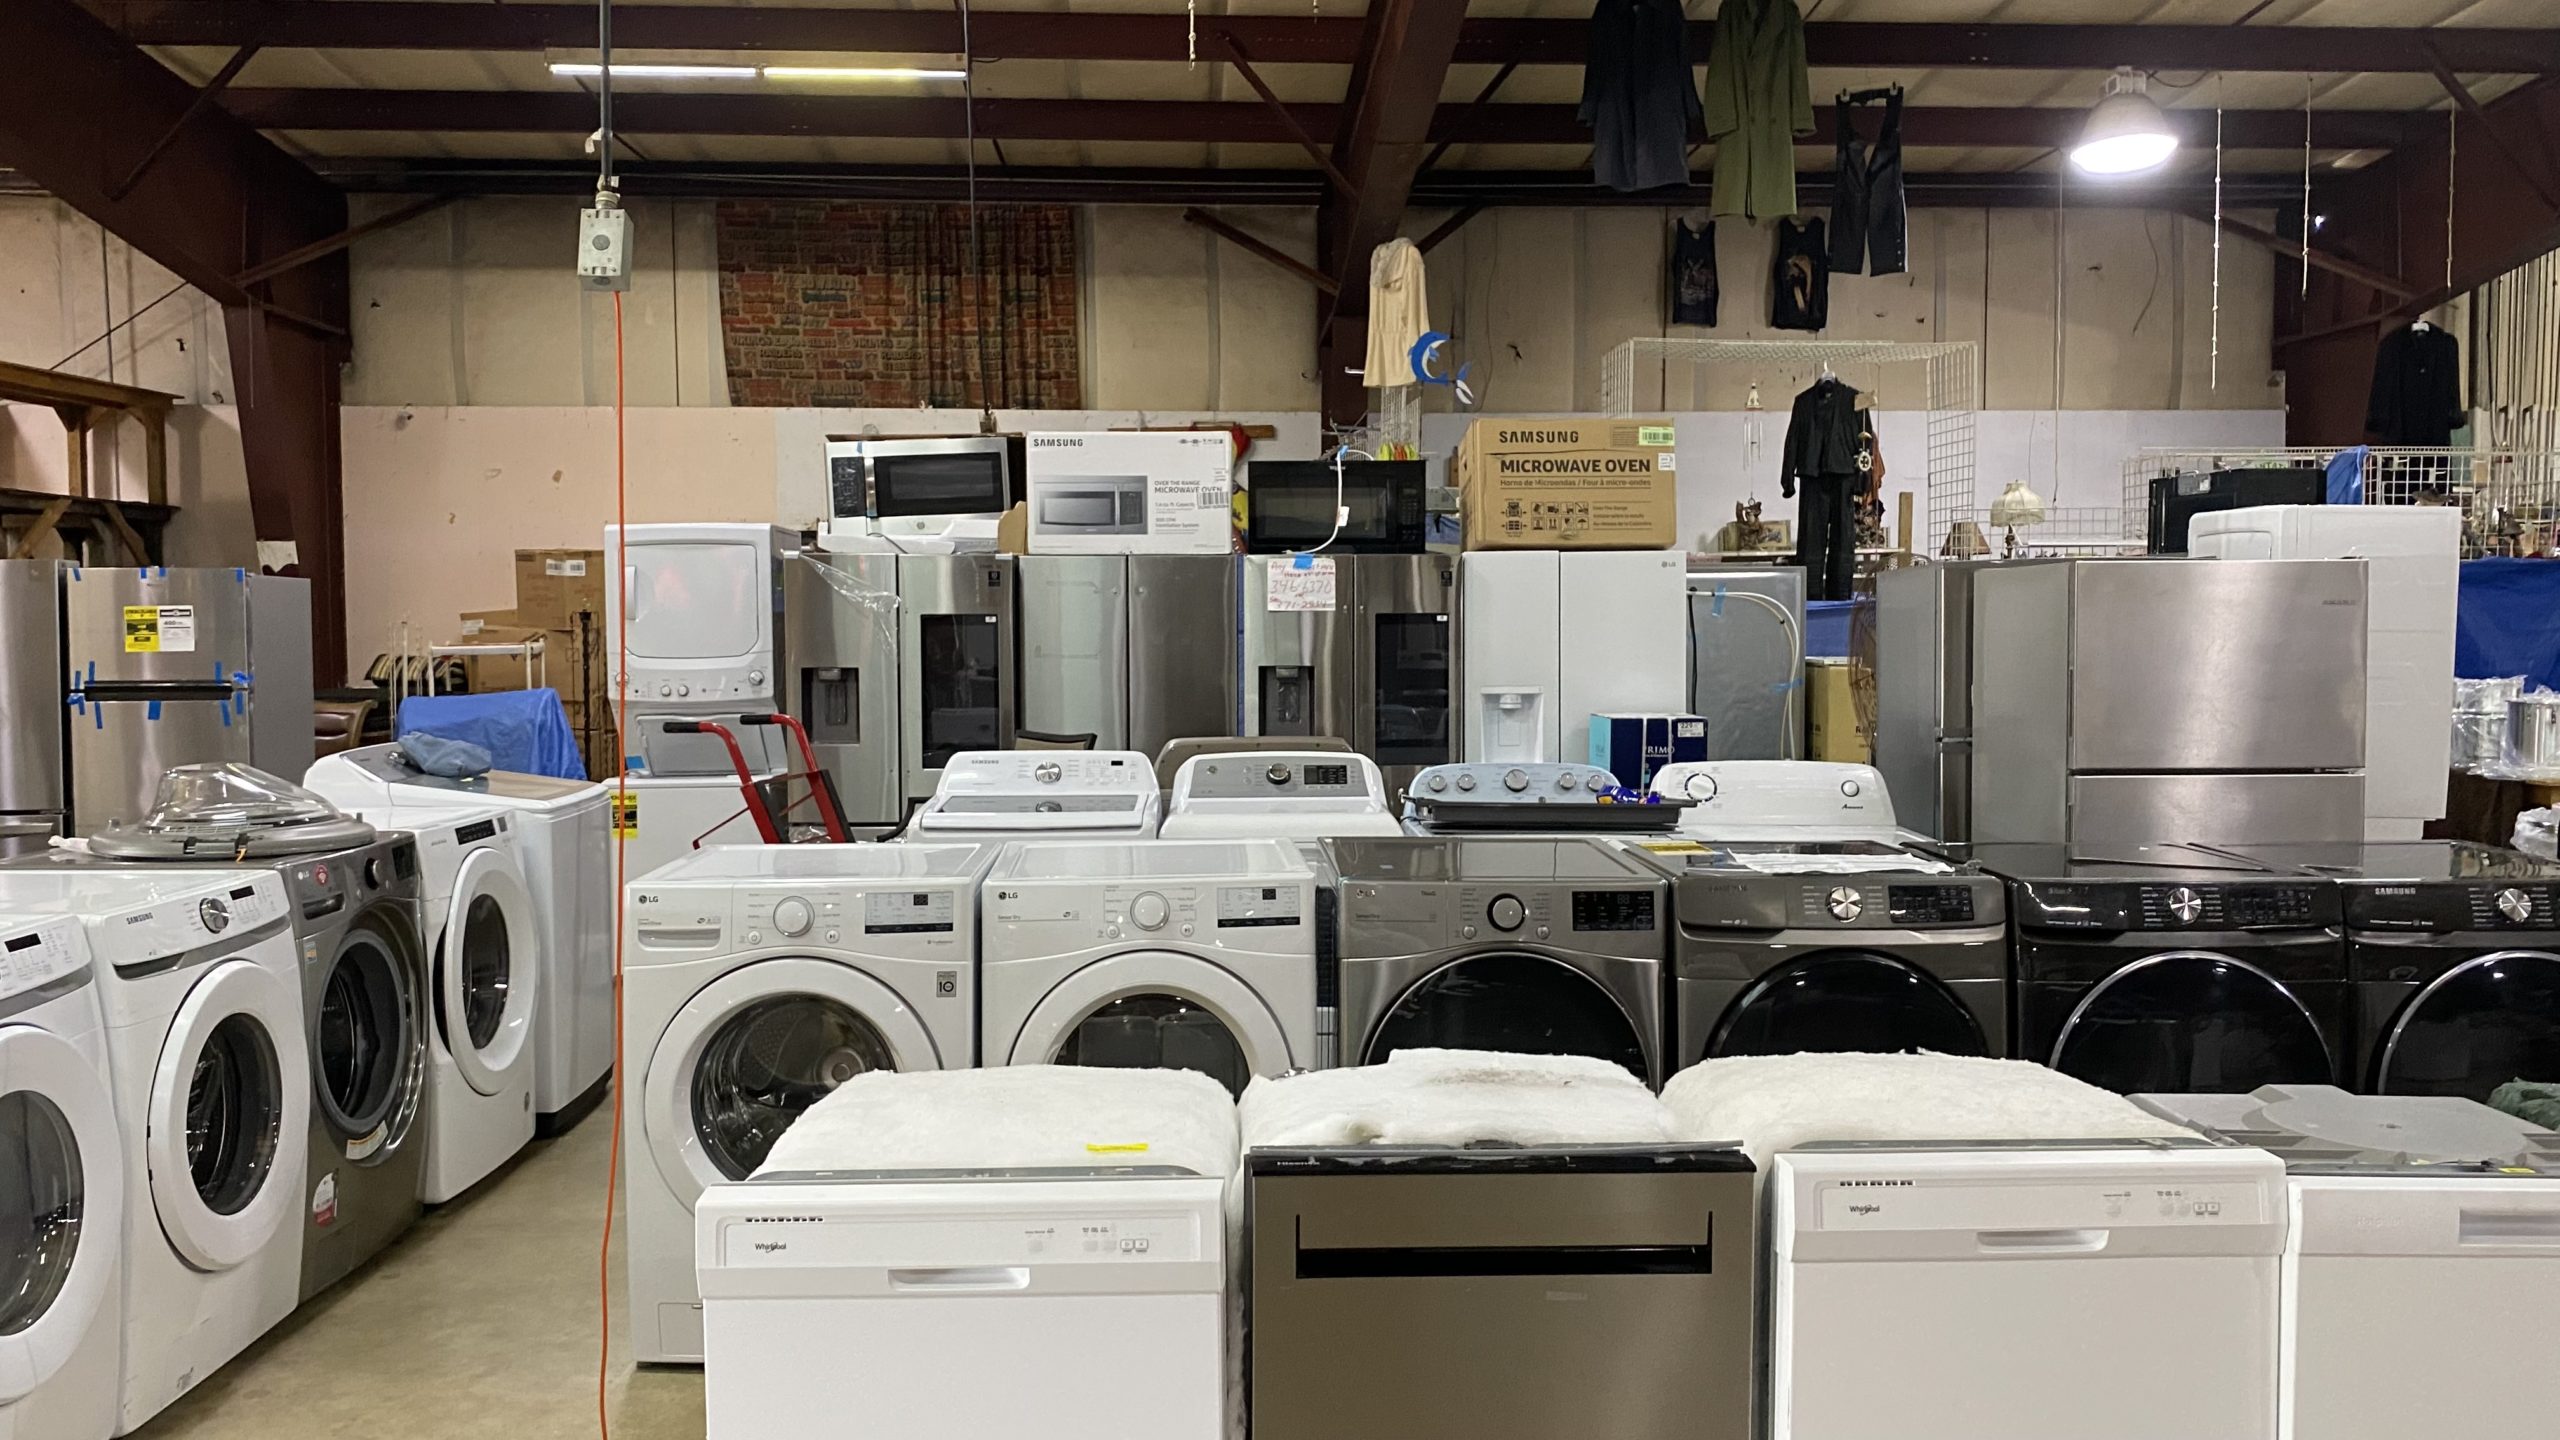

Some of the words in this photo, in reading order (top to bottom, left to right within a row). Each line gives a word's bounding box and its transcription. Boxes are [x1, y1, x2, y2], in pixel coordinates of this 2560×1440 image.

[1499, 430, 1579, 443] SAMSUNG
[1033, 438, 1084, 447] SAMSUNG
[1500, 459, 1601, 473] MICROWAVE
[1605, 459, 1651, 473] OVEN
[1642, 745, 1676, 754] RIMO
[2375, 887, 2416, 895] SAMSUNG
[126, 912, 154, 925] SAMSUNG
